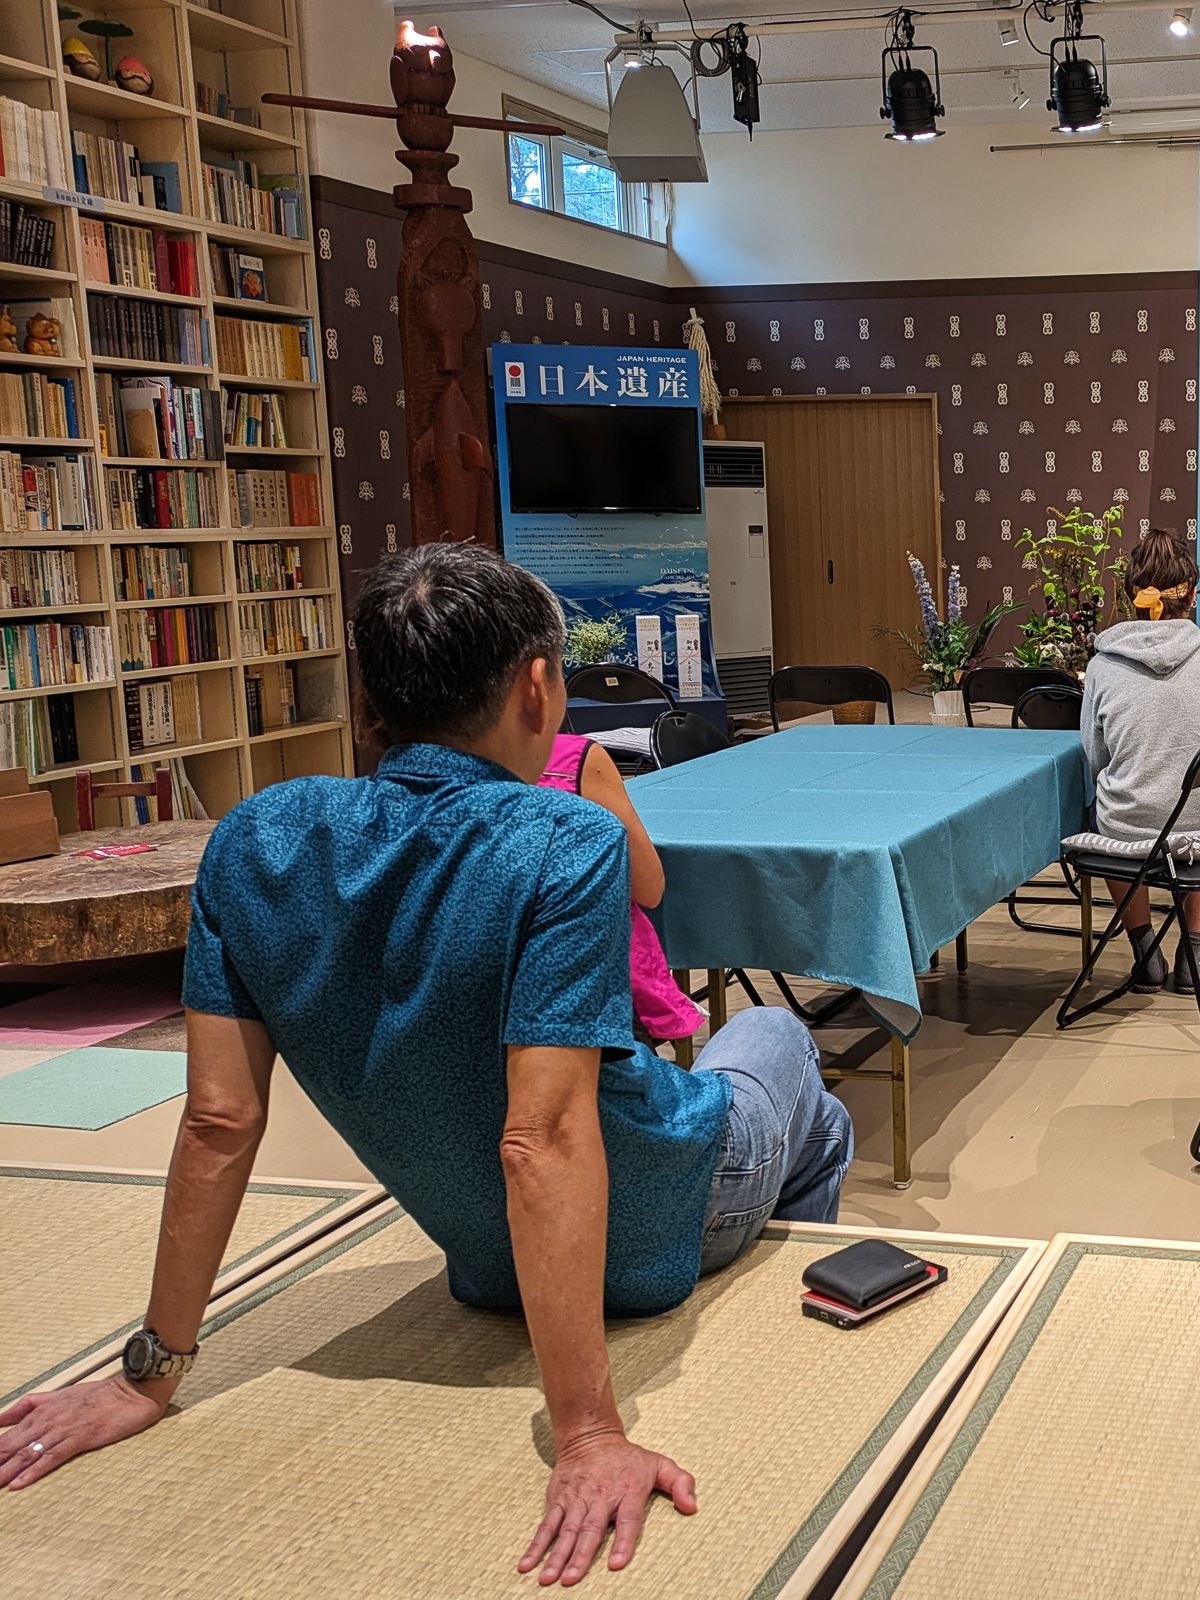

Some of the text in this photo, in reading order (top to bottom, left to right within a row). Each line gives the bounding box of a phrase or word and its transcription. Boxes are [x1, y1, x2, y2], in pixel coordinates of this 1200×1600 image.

[646, 356, 687, 364] HERITAGE
[539, 365, 690, 399] 日本遺産
